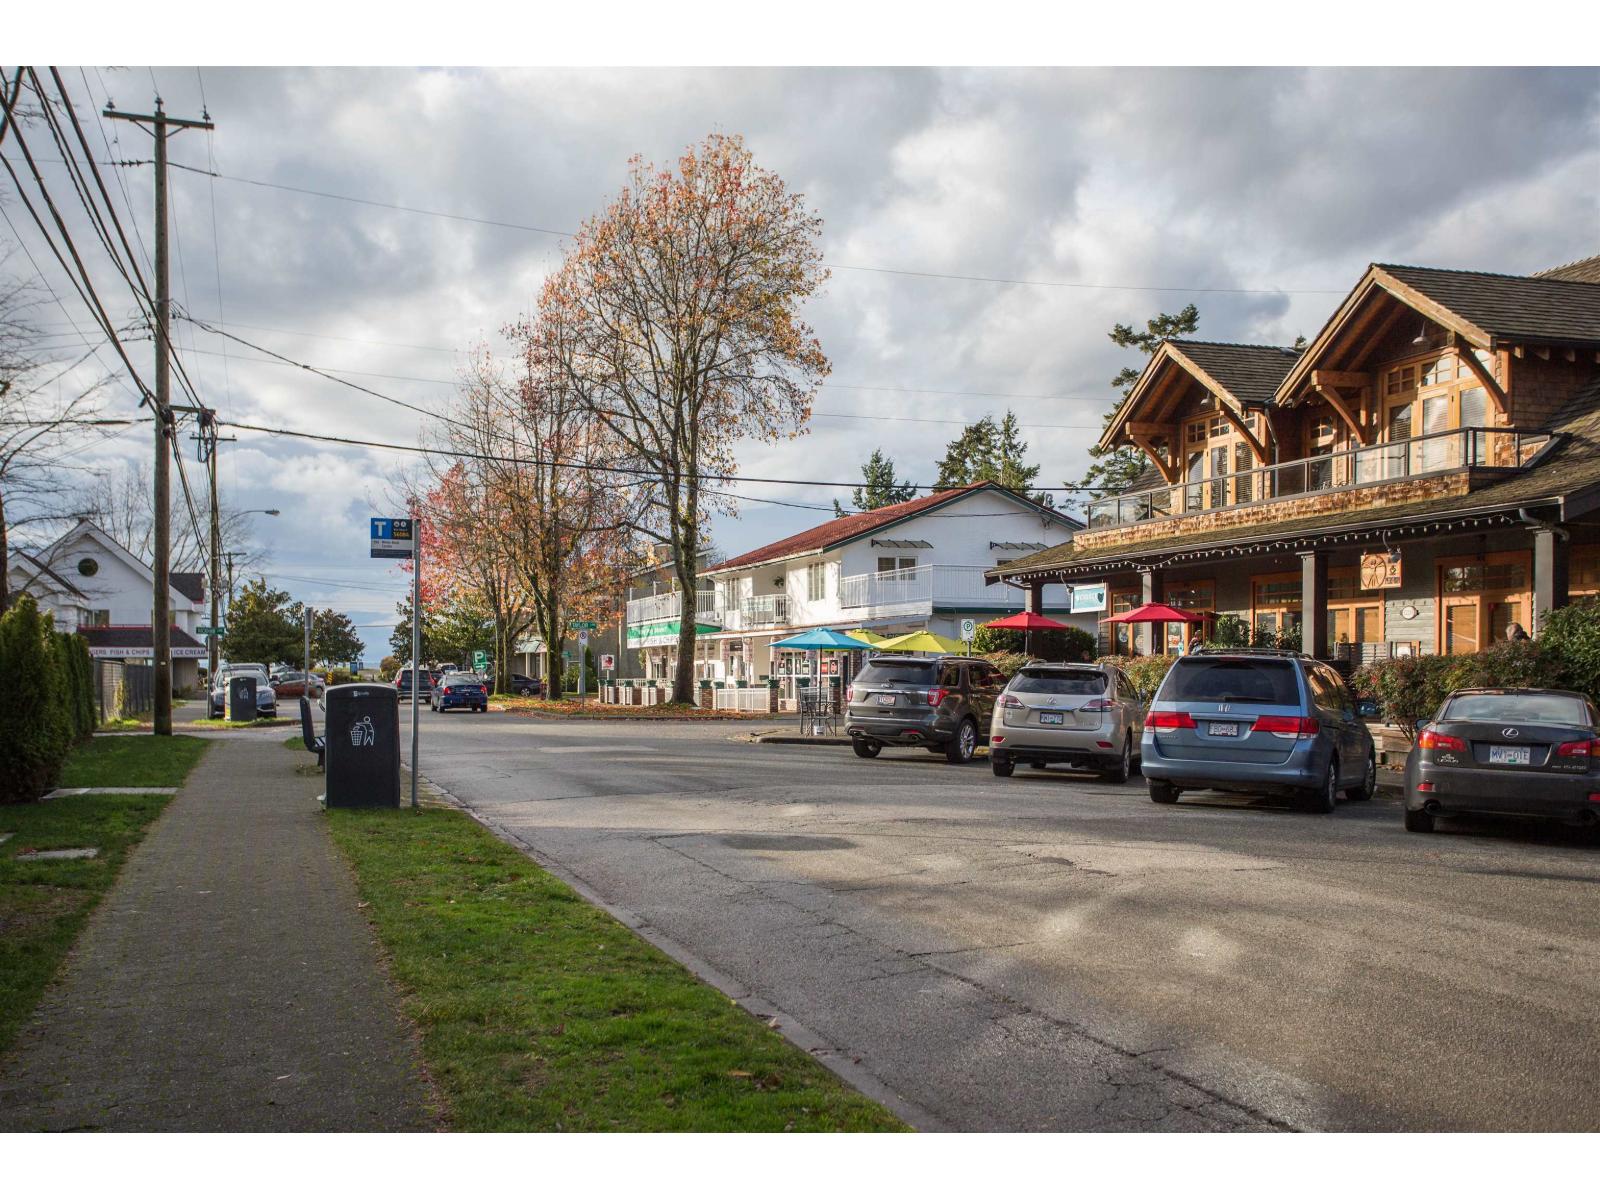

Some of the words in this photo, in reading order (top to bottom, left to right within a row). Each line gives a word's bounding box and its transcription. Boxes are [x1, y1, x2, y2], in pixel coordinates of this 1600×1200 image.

[374, 521, 387, 537] T
[174, 648, 184, 656] ICE
[185, 648, 206, 656] CREAM
[475, 652, 484, 663] P
